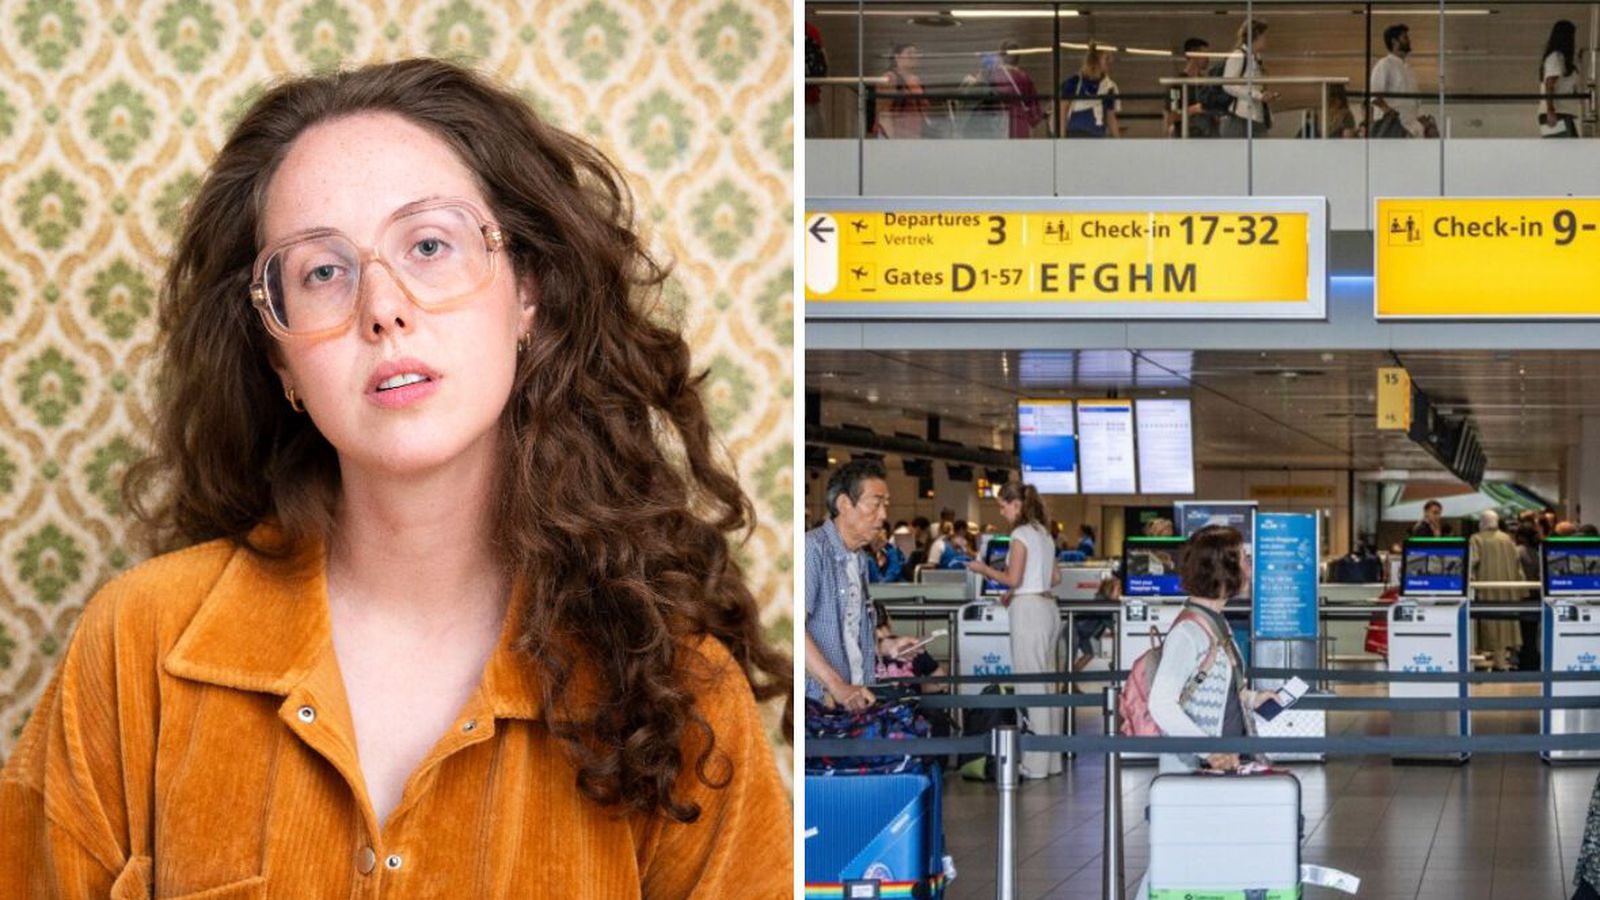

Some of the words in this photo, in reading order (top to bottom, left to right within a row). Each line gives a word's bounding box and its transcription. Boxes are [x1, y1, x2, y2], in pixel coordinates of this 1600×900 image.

[885, 212, 980, 228] Departures
[988, 216, 1006, 245] 3
[1081, 221, 1170, 238] Check-in
[1180, 216, 1279, 245] 17-32
[1433, 216, 1543, 237] Check-in
[885, 234, 934, 245] Vertrek
[885, 268, 943, 285] Gates
[952, 264, 976, 292] D
[981, 269, 1023, 285] 1-57
[1385, 373, 1399, 385] 15
[973, 664, 1011, 676] KLM
